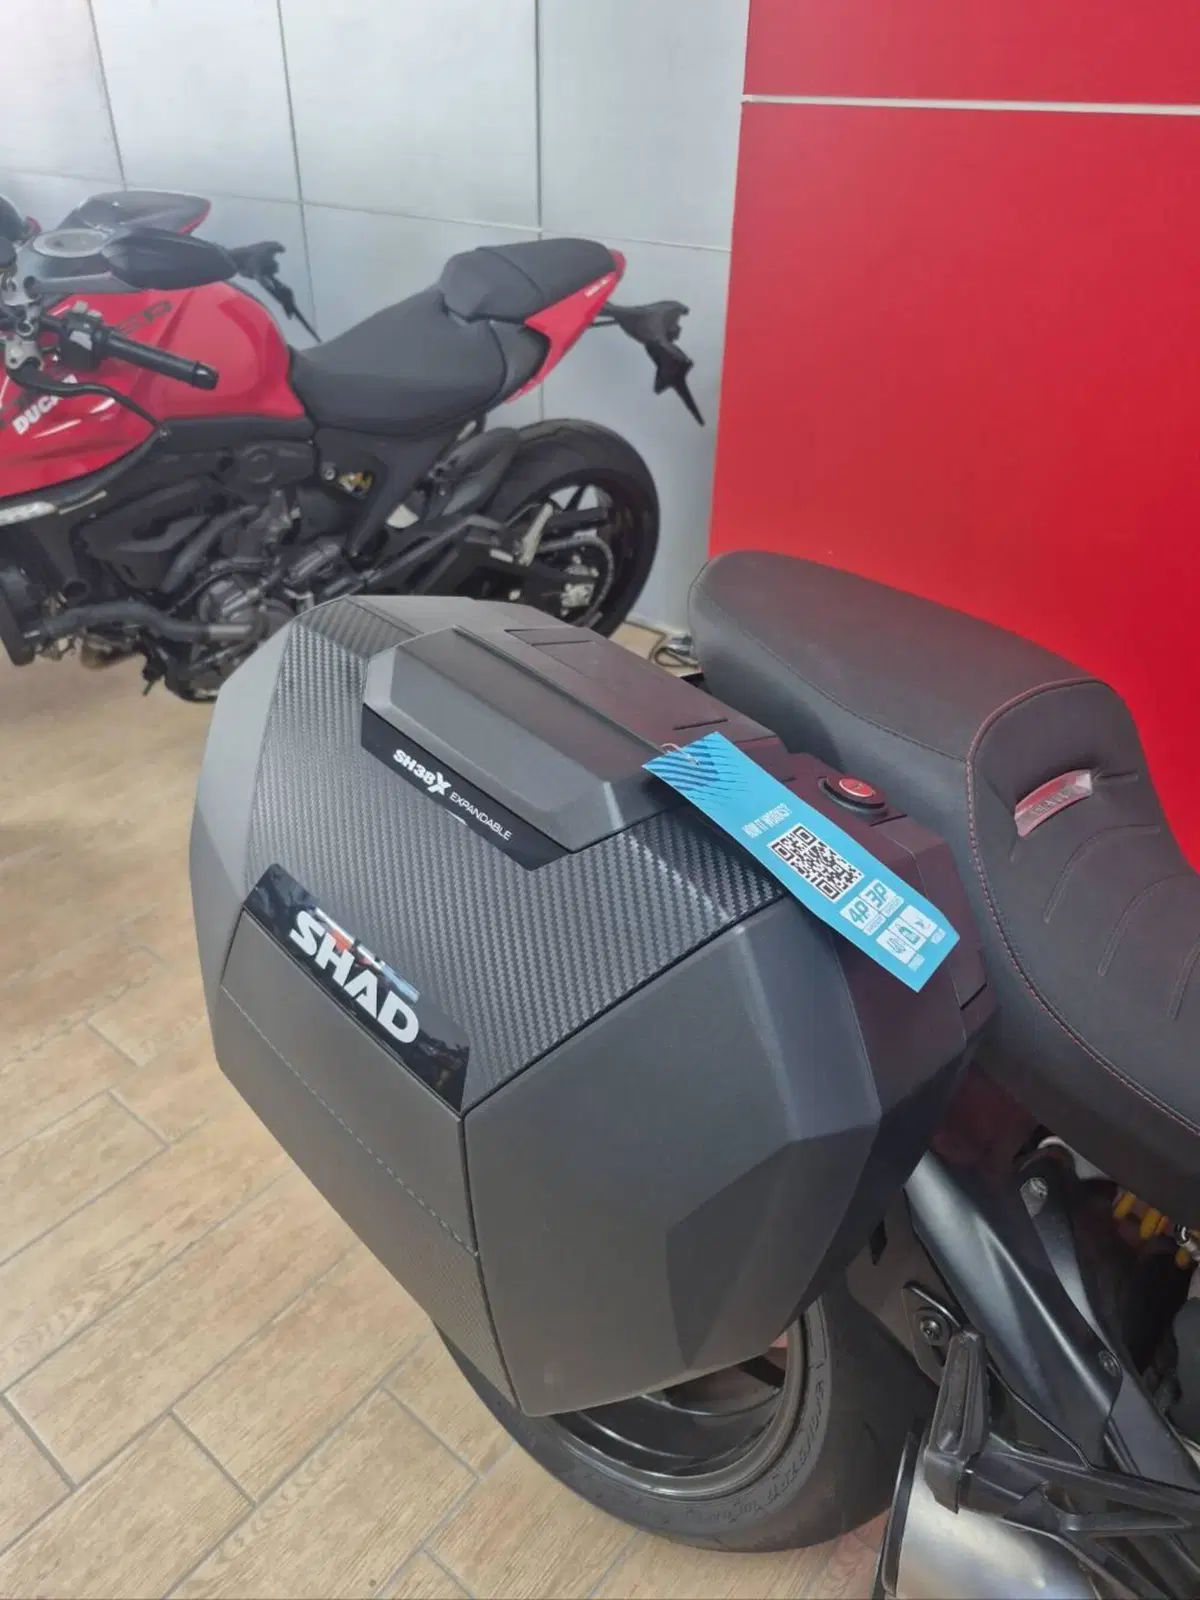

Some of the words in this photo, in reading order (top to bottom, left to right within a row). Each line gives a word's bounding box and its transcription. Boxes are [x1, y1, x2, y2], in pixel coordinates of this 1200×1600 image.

[393, 749, 451, 795] SH38X
[450, 791, 513, 841] EXPANDABLE
[289, 910, 420, 1044] SHAD
